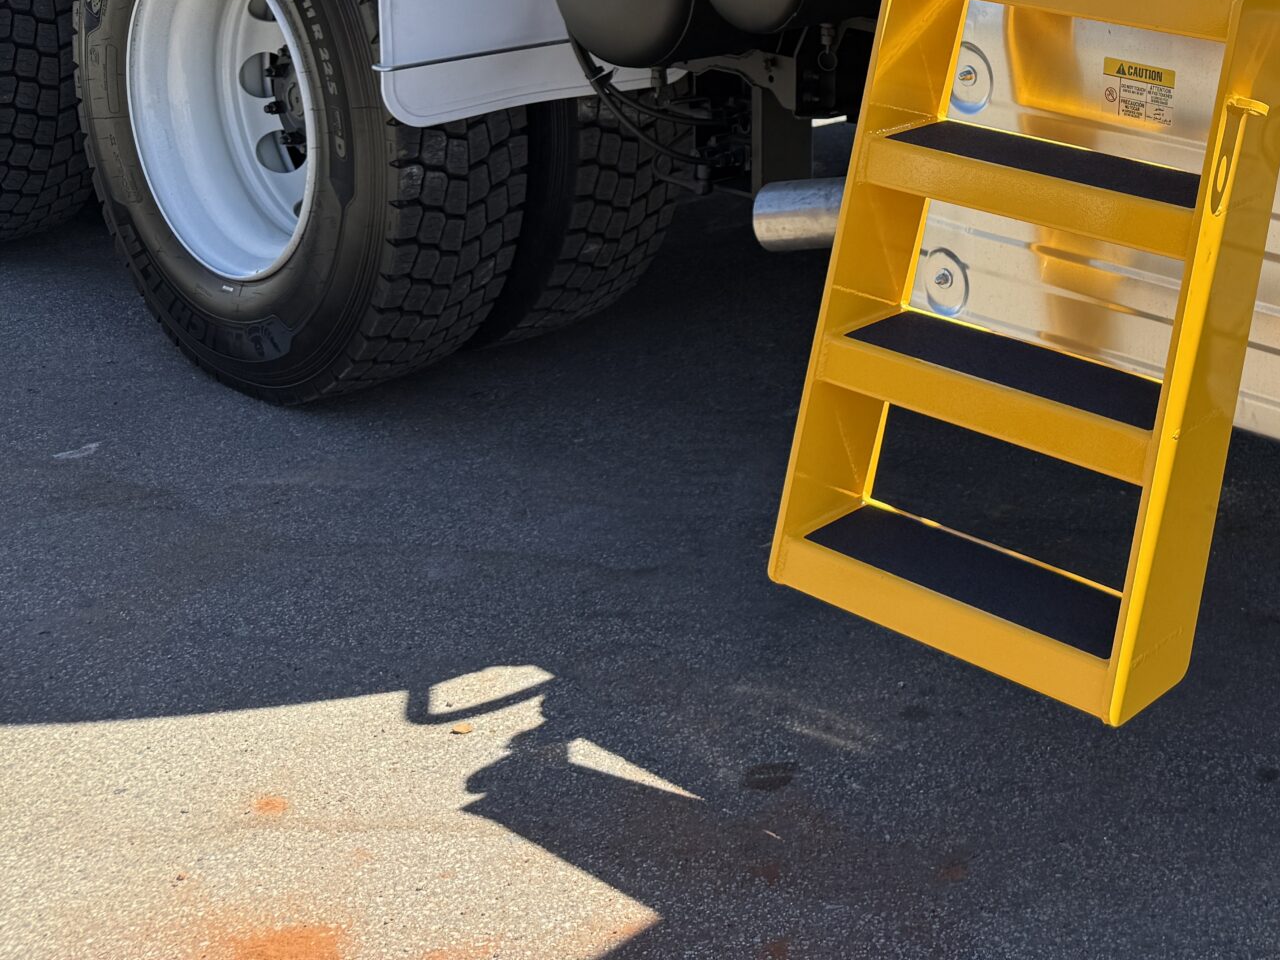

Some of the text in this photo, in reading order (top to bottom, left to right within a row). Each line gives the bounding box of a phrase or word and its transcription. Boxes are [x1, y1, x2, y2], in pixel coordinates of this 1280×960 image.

[312, 24, 323, 40] R
[318, 48, 338, 96] 22.5
[1128, 65, 1162, 82] CAUTION
[1150, 85, 1172, 94] ATTENTION
